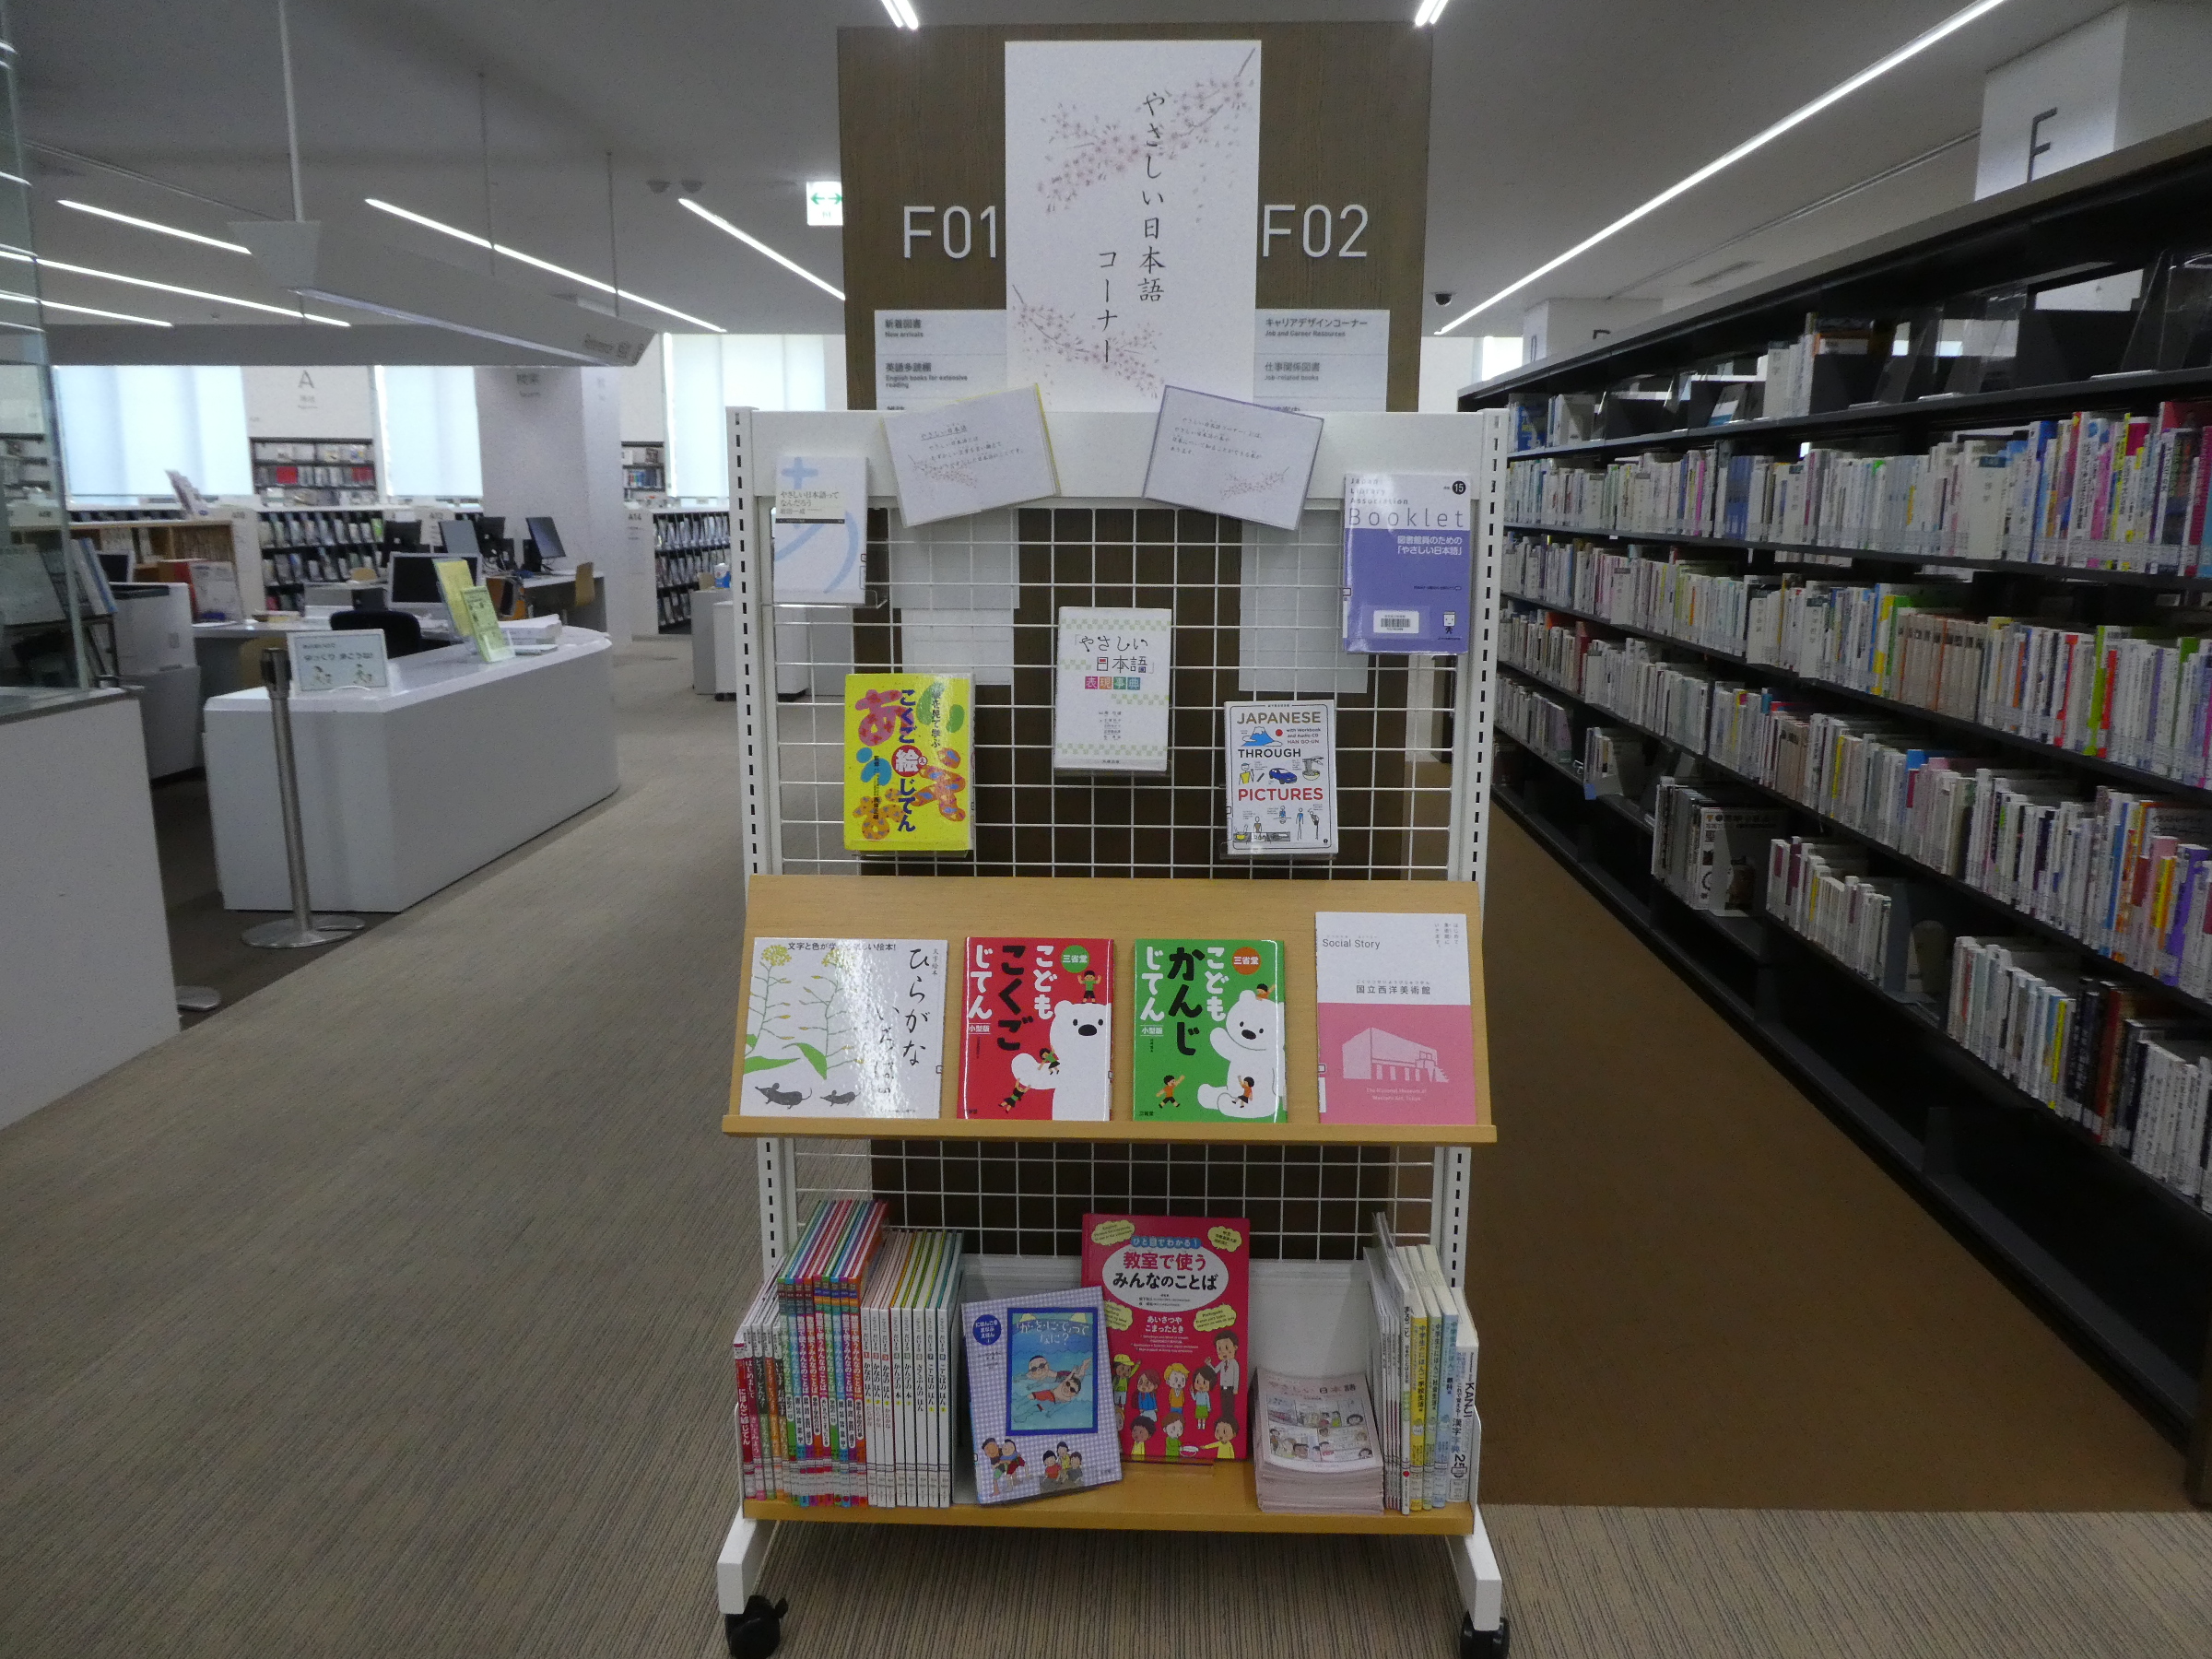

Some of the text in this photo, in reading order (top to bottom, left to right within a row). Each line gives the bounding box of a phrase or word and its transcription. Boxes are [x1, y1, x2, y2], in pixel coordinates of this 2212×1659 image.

[1138, 89, 1171, 303] やさしい日本語
[903, 206, 997, 258] F01
[1263, 204, 1369, 258] F02
[1097, 250, 1118, 363] コーナー
[1265, 318, 1368, 327] キャリアデザインコーナー
[1265, 362, 1320, 371] 仕事関係図書
[298, 370, 314, 388] A
[1350, 488, 1385, 496] Library
[1454, 483, 1464, 493] 15
[1349, 508, 1464, 527] Booklet
[1397, 535, 1463, 545] 図書館員のための
[1397, 547, 1463, 556] 「やさしい日本語」
[1097, 655, 1154, 674] 日本語」
[1085, 677, 1141, 690] 表現事典
[1237, 712, 1322, 724] JAPANESE
[1238, 748, 1301, 759] THROUGH
[1238, 787, 1324, 801] PICTURES
[1323, 938, 1381, 949] Social Story
[1062, 954, 1088, 963] 三省堂
[1233, 956, 1259, 965] 三省堂
[969, 945, 993, 1019] じてん
[1033, 945, 1057, 1019] こども
[1140, 946, 1164, 1021] じてん
[1205, 947, 1230, 1021] こども
[1357, 985, 1430, 994] 国立西洋美術館
[997, 945, 1033, 1051] こくご
[1168, 947, 1206, 1055] かんじ
[903, 948, 930, 1066] ひらがな
[1141, 1027, 1164, 1035] 小型版
[1133, 1237, 1198, 1248] ひと目でわかる!
[1123, 1252, 1206, 1271] 教室で使う
[1112, 1273, 1218, 1290] みんなのことば
[1147, 1315, 1182, 1324] あいさつや
[1145, 1324, 1184, 1334] こまったとき
[1040, 1333, 1069, 1346] なに?
[1463, 1382, 1475, 1418] KANJI
[739, 1388, 750, 1445] にほんご絵じてん
